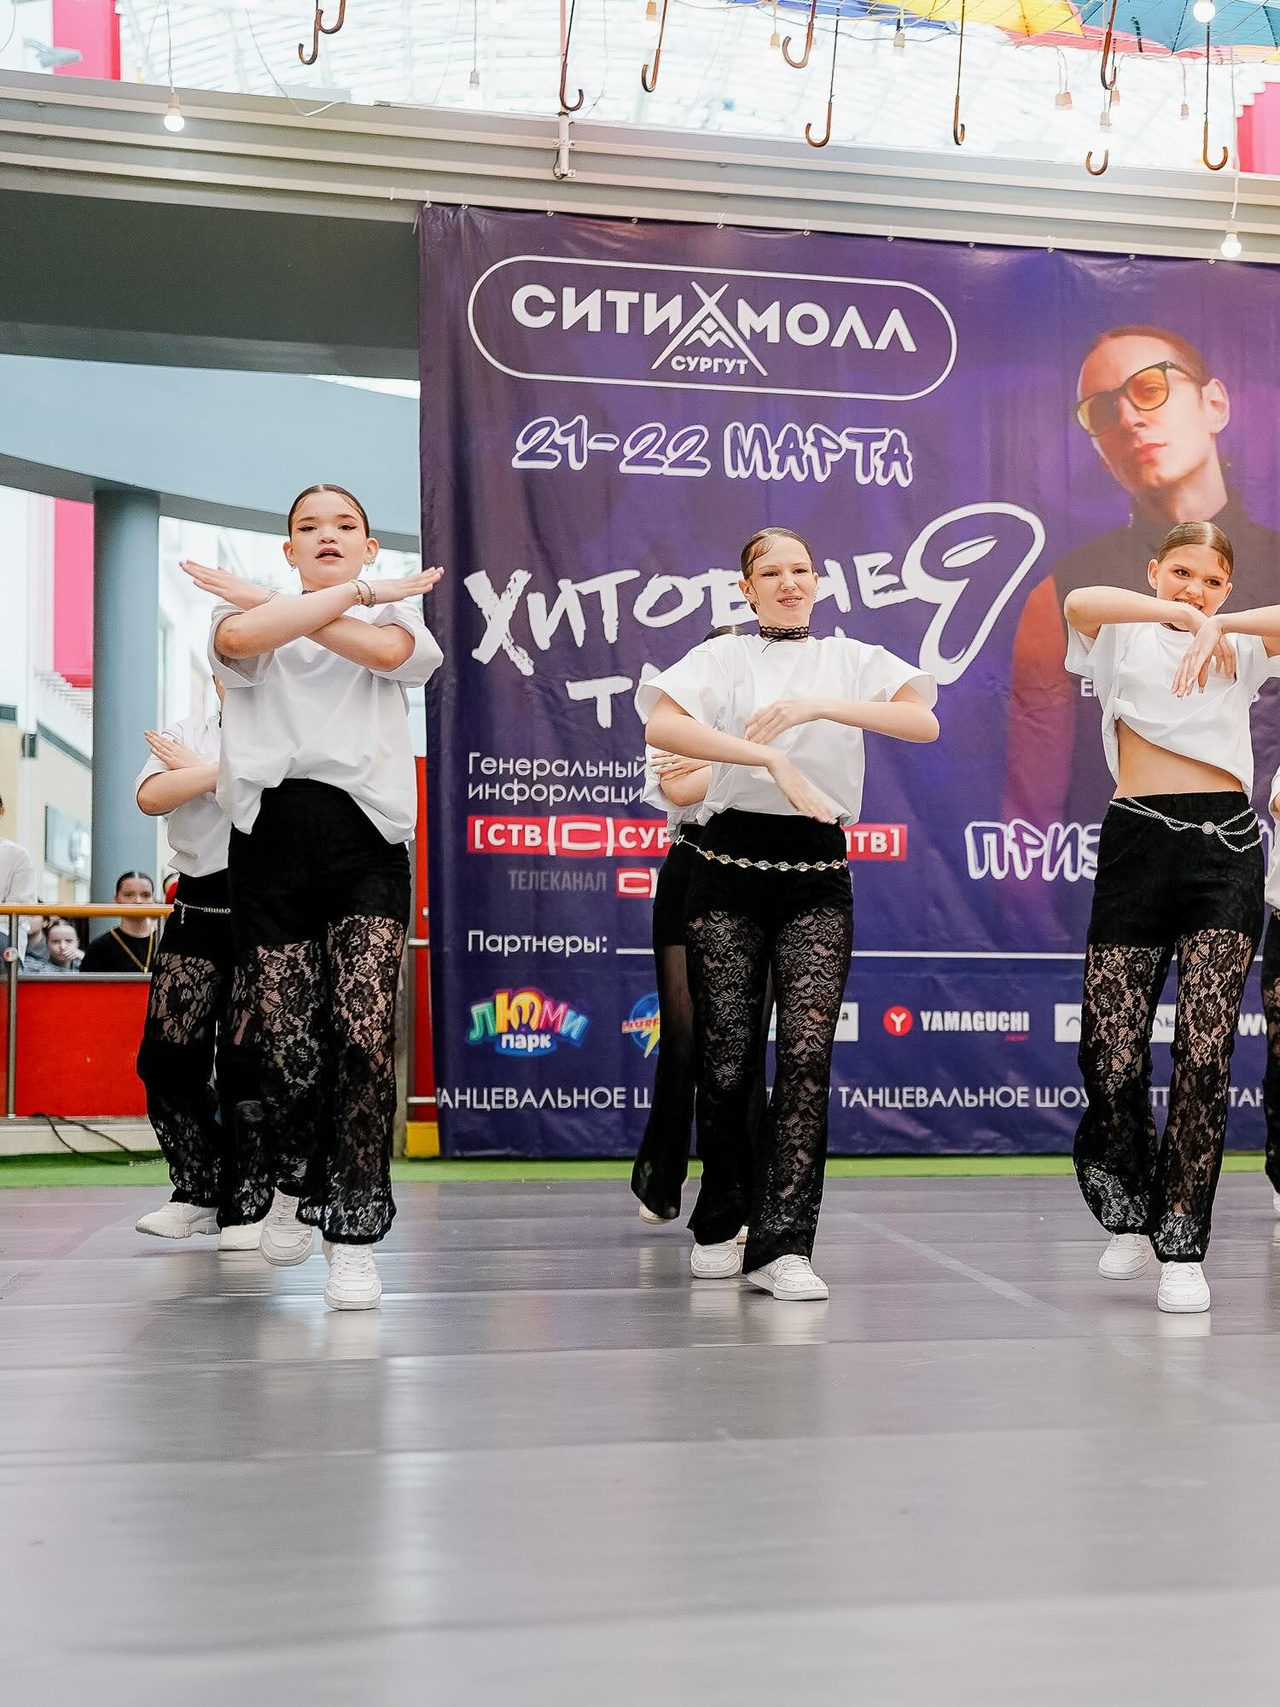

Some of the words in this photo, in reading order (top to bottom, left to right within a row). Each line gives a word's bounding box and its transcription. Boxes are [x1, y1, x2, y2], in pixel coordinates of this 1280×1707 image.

[511, 284, 682, 335] СИТИ
[738, 299, 917, 352] МОЛЛ
[671, 355, 748, 375] СУРГУТ
[511, 414, 711, 476] 21-22
[724, 421, 913, 488] МАРТА
[468, 779, 645, 806] информаци
[508, 869, 607, 892] ТЕЛЕКАНАЛ
[468, 930, 607, 957] Партнеры:
[468, 990, 589, 1042] ЛЮМИ
[920, 1010, 1030, 1032] YAMAGUCHI
[501, 1033, 552, 1052] парк
[838, 1086, 1030, 1110] ТАНЦЕВАЛЬНОЕ
